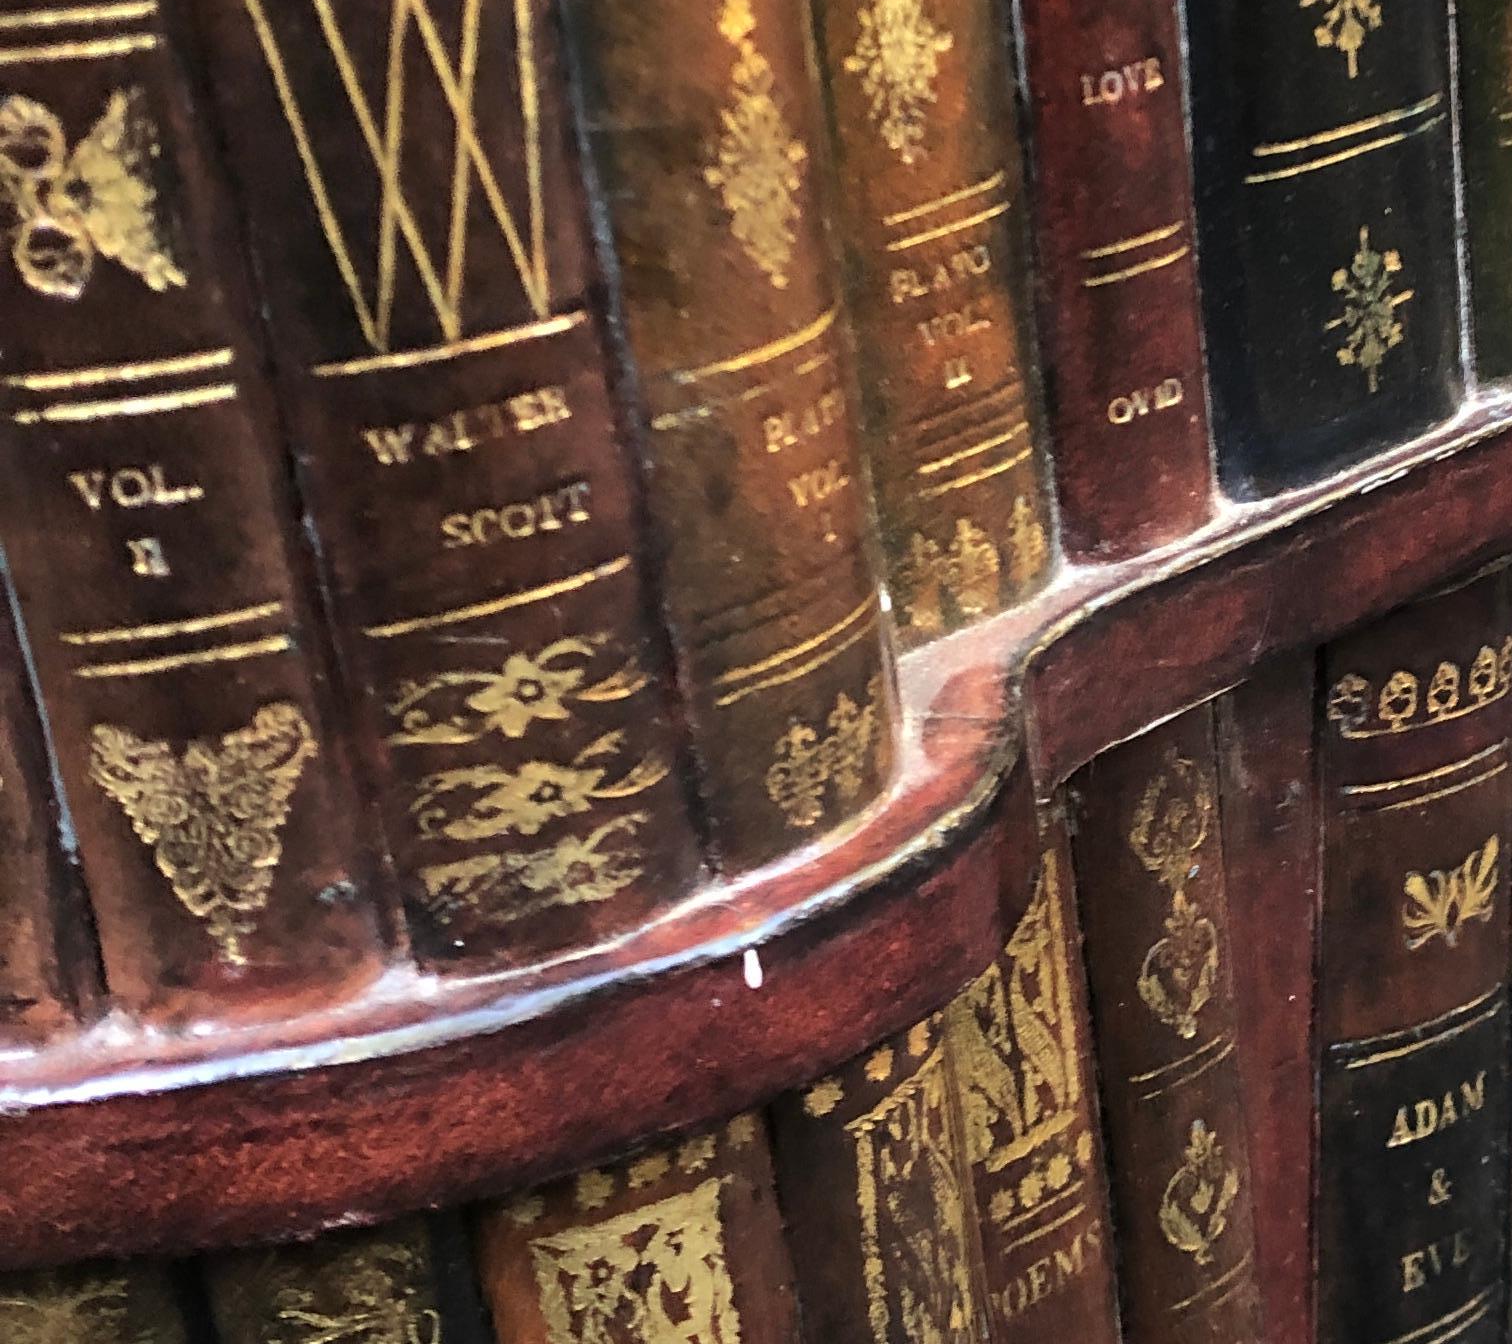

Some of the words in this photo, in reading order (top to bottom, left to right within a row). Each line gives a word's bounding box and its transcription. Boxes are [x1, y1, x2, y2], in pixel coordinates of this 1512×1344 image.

[1080, 57, 1166, 106] LOVE
[889, 243, 992, 305] PLATO
[360, 385, 573, 466] WALTER
[1108, 378, 1184, 424] OVID
[441, 481, 592, 549] SCOTT
[1385, 1069, 1488, 1149] ADAM
[1427, 1166, 1453, 1206] &
